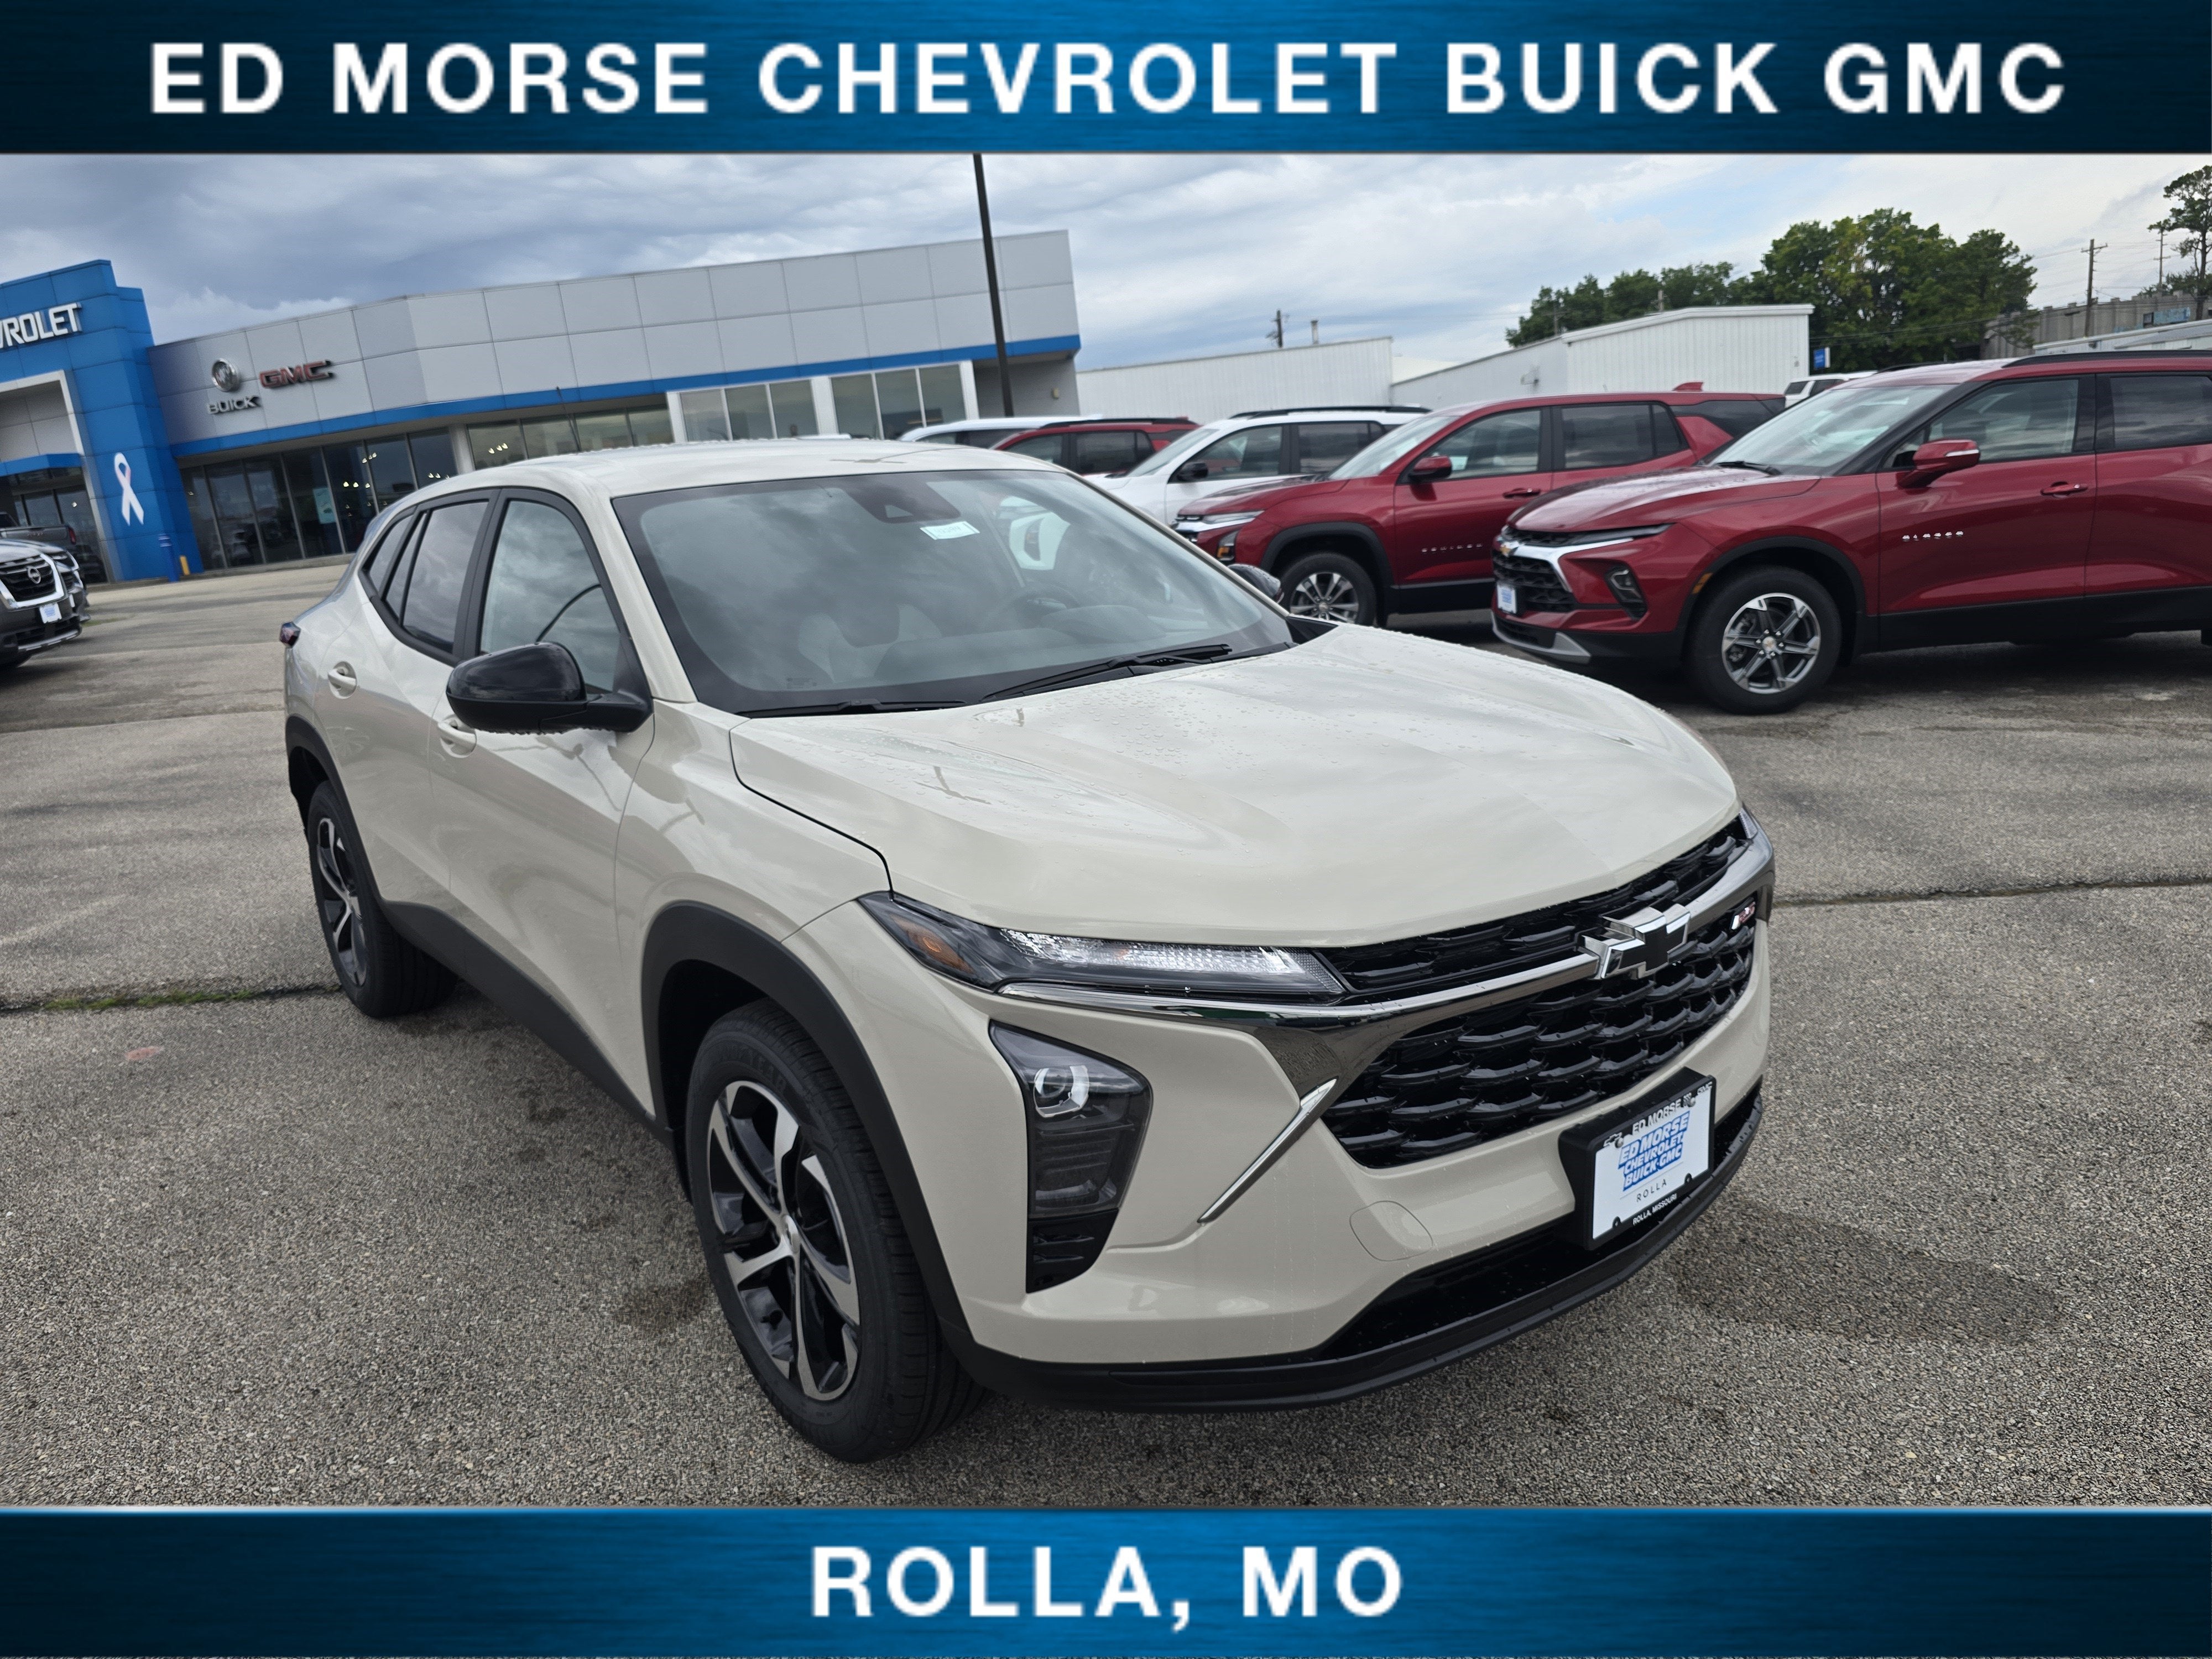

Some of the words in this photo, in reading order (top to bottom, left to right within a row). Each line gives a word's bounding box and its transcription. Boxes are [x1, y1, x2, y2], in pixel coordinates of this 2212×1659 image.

[0, 302, 79, 349] ROLET
[259, 360, 332, 389] GMC
[207, 395, 259, 414] BUICK
[1632, 1119, 1646, 1134] ED
[1647, 1099, 1682, 1126] MORSE
[1619, 1141, 1640, 1165] ED
[1640, 1113, 1689, 1155] MORSE
[1624, 1133, 1684, 1175] CHEVROLET
[1636, 1179, 1667, 1202] ROLLA
[1652, 1193, 1678, 1213] MISSOURI
